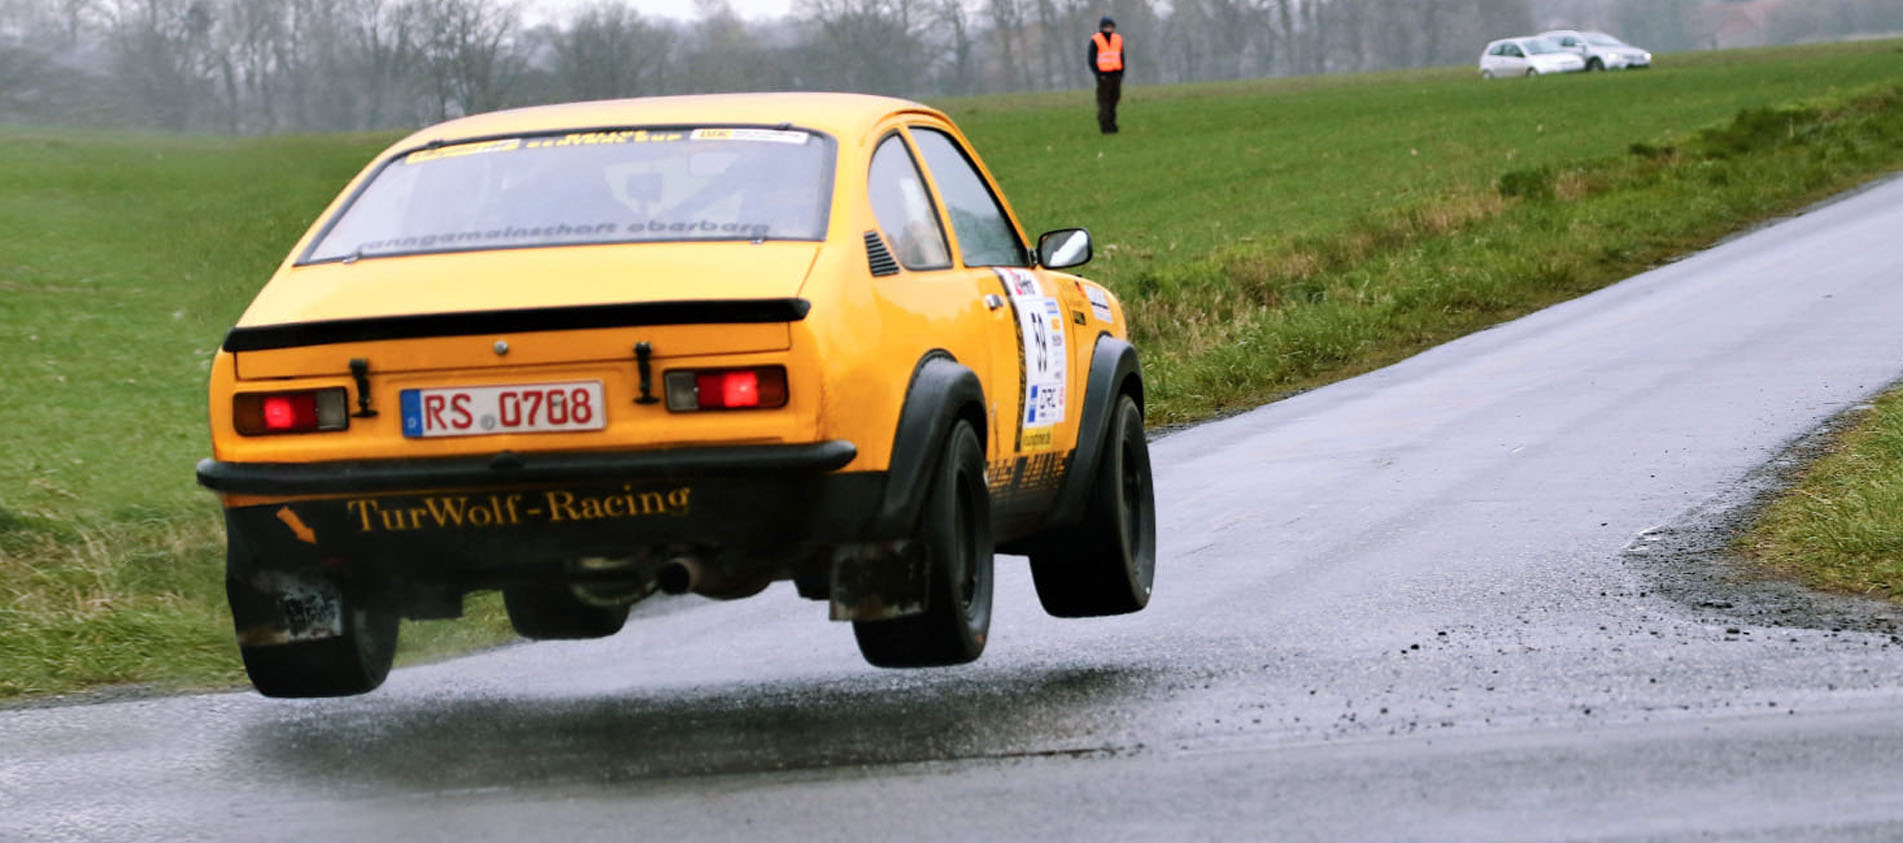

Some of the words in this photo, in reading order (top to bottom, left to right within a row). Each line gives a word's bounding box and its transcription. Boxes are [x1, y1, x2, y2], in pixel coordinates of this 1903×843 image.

[424, 393, 474, 431] RS
[498, 387, 593, 428] 0708
[347, 485, 691, 532] TurWolf-Racing
